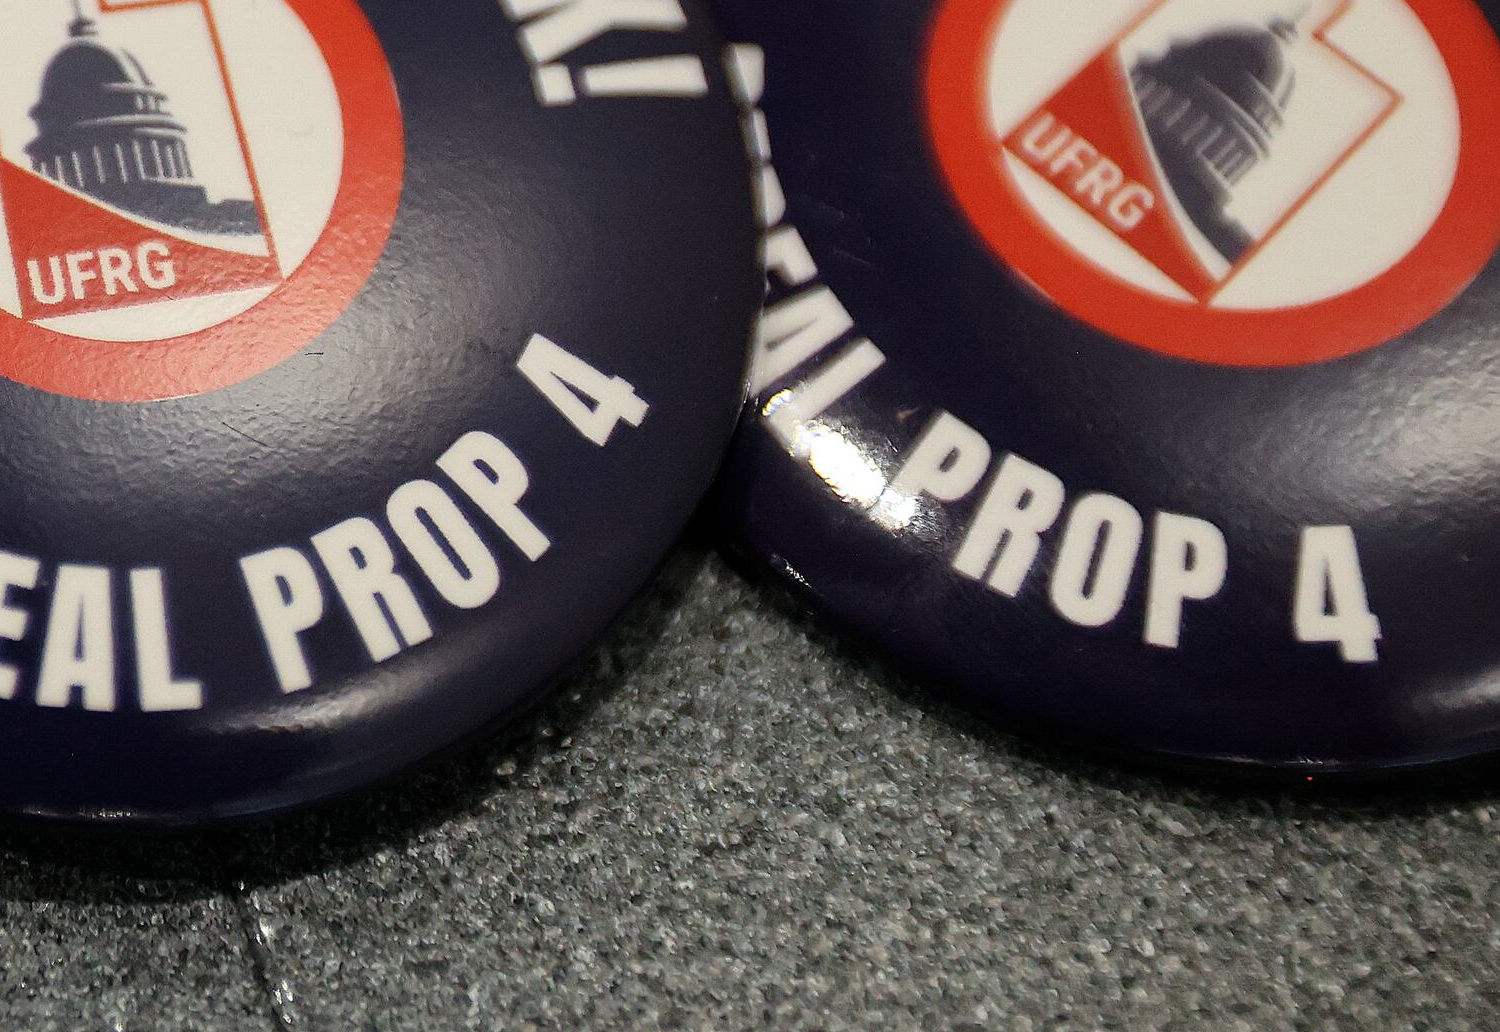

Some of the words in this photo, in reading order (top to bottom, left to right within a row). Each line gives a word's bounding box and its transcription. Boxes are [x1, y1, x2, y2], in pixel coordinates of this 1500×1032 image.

[1021, 110, 1158, 235] UFRG
[24, 238, 178, 308] UFRG
[238, 428, 554, 697] PROP
[514, 331, 652, 448] 4
[872, 408, 1230, 652] PROP
[1292, 524, 1384, 666] 4
